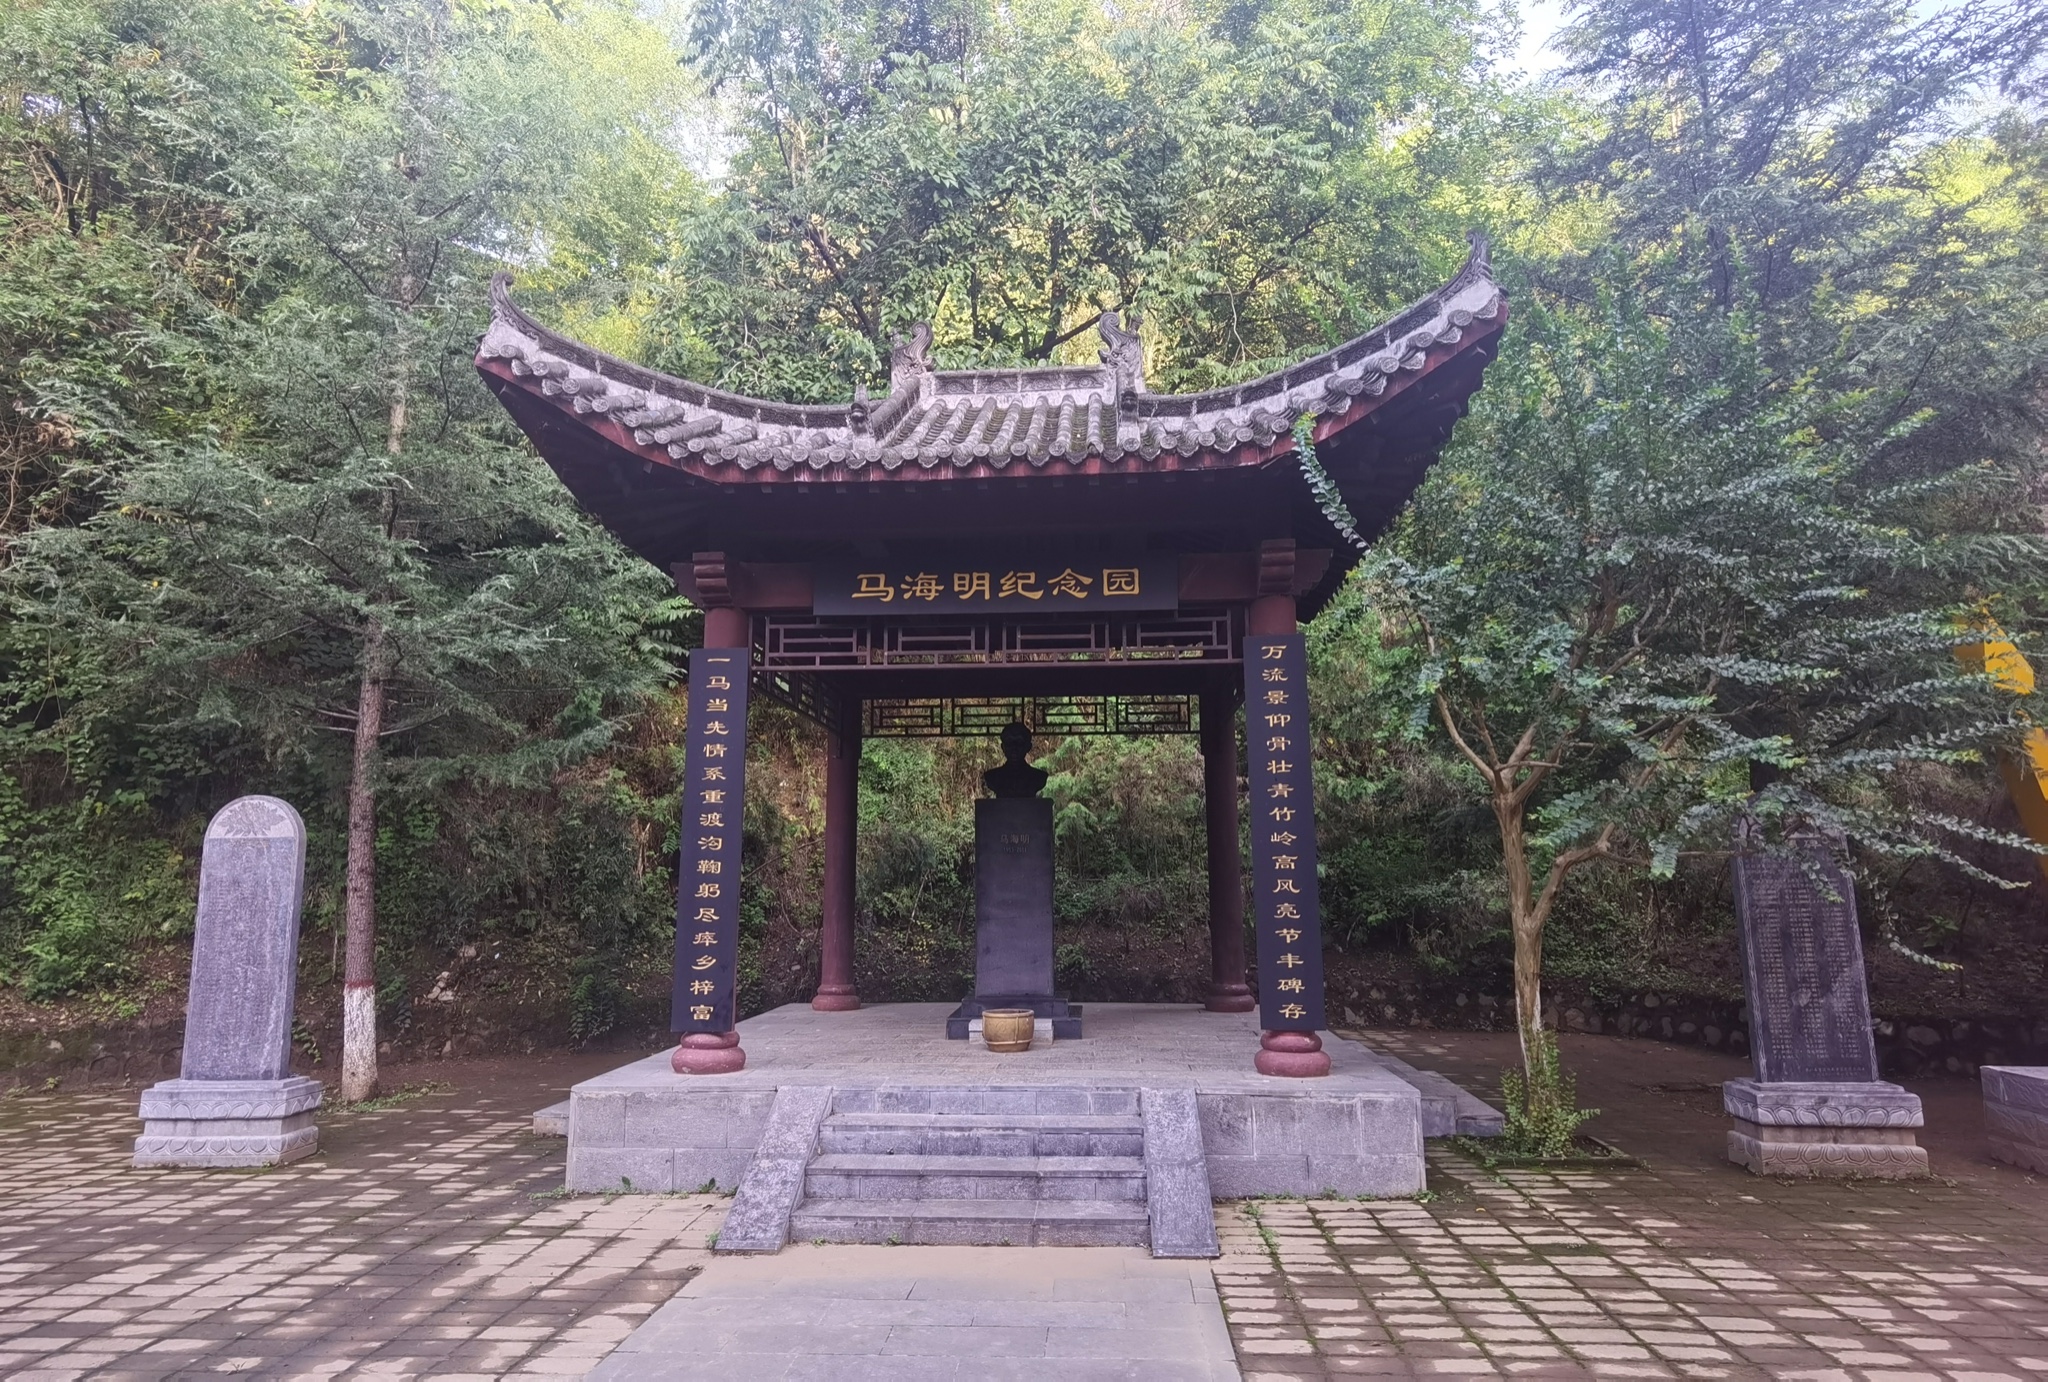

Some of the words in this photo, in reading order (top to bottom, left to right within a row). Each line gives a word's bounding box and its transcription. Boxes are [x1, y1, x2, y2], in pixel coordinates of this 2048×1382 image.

[853, 567, 1140, 602] 马海明纪念园
[689, 657, 731, 1021] 一马当先情系重渡沟鞠躬尽瘁乡梓富
[1261, 645, 1307, 1019] 万流景仰骨壮青竹岭高风亮节丰碑存
